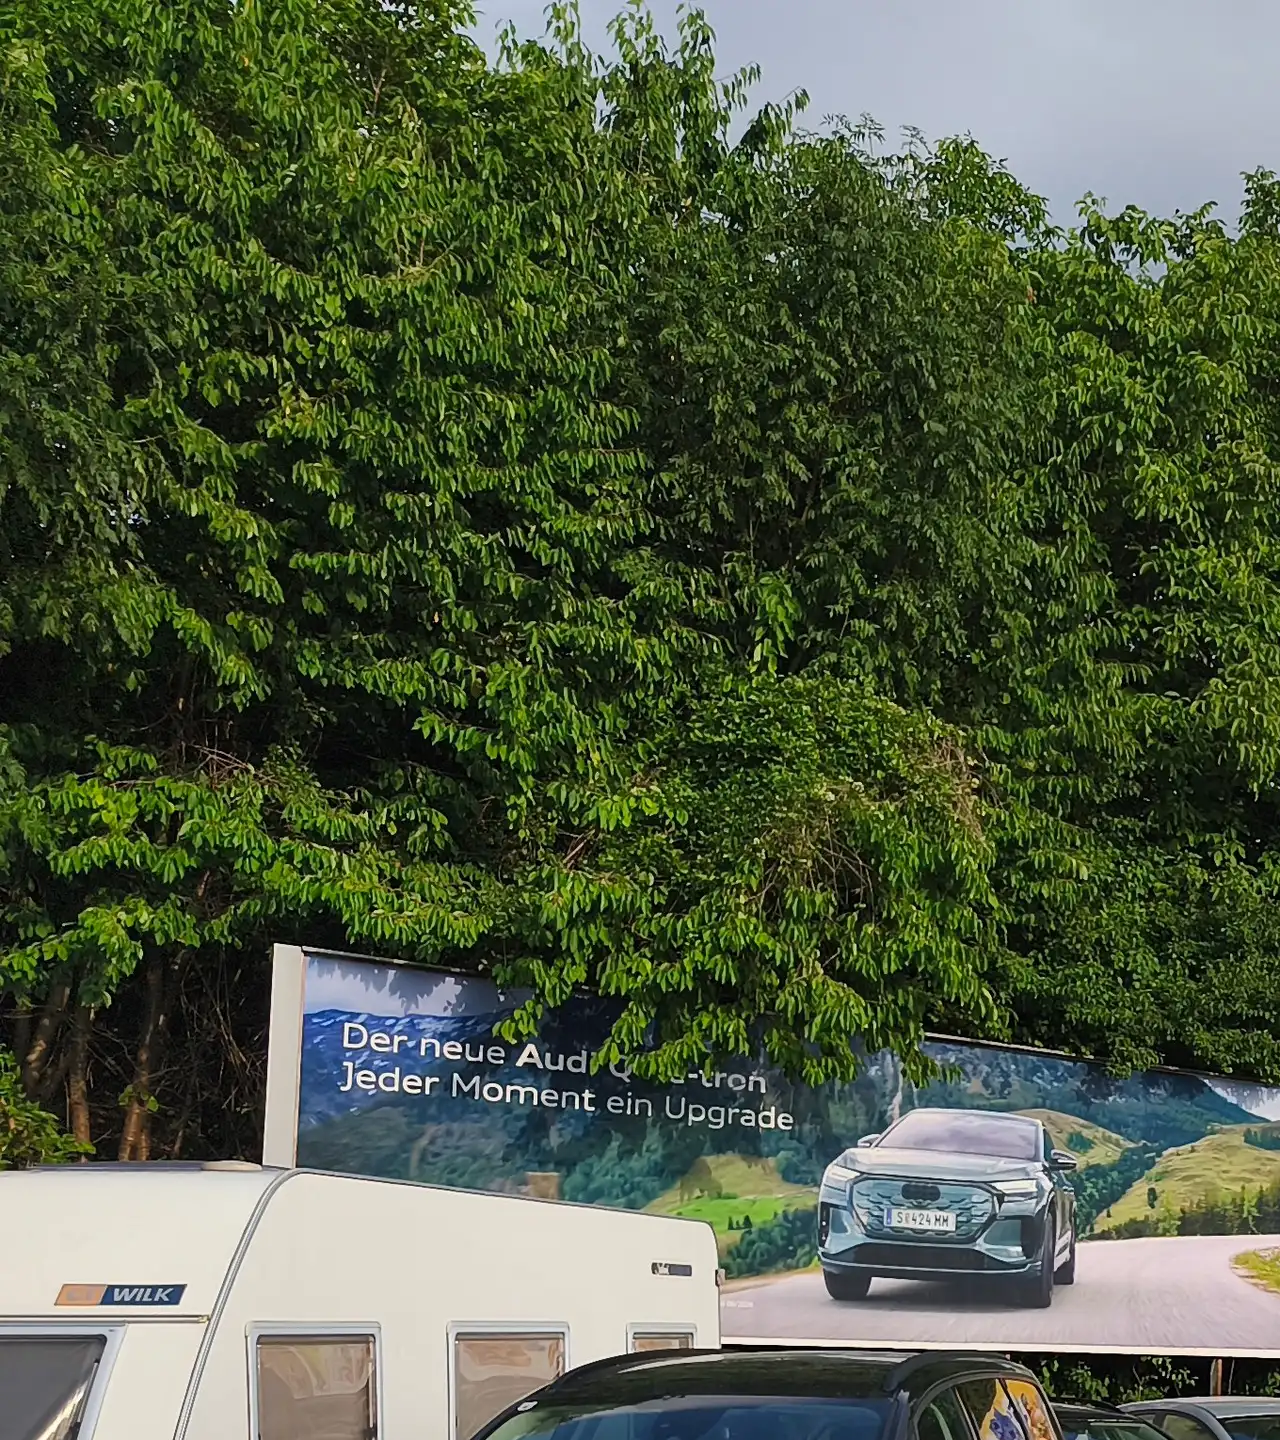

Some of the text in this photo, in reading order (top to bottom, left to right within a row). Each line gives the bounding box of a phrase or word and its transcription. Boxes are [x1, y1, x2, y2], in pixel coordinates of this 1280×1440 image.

[342, 1022, 408, 1054] Der
[420, 1036, 506, 1065] neue
[515, 1043, 593, 1076] Aud
[340, 1062, 795, 1131] Jeder Moment ein Upgrade
[113, 1287, 175, 1302] WILK
